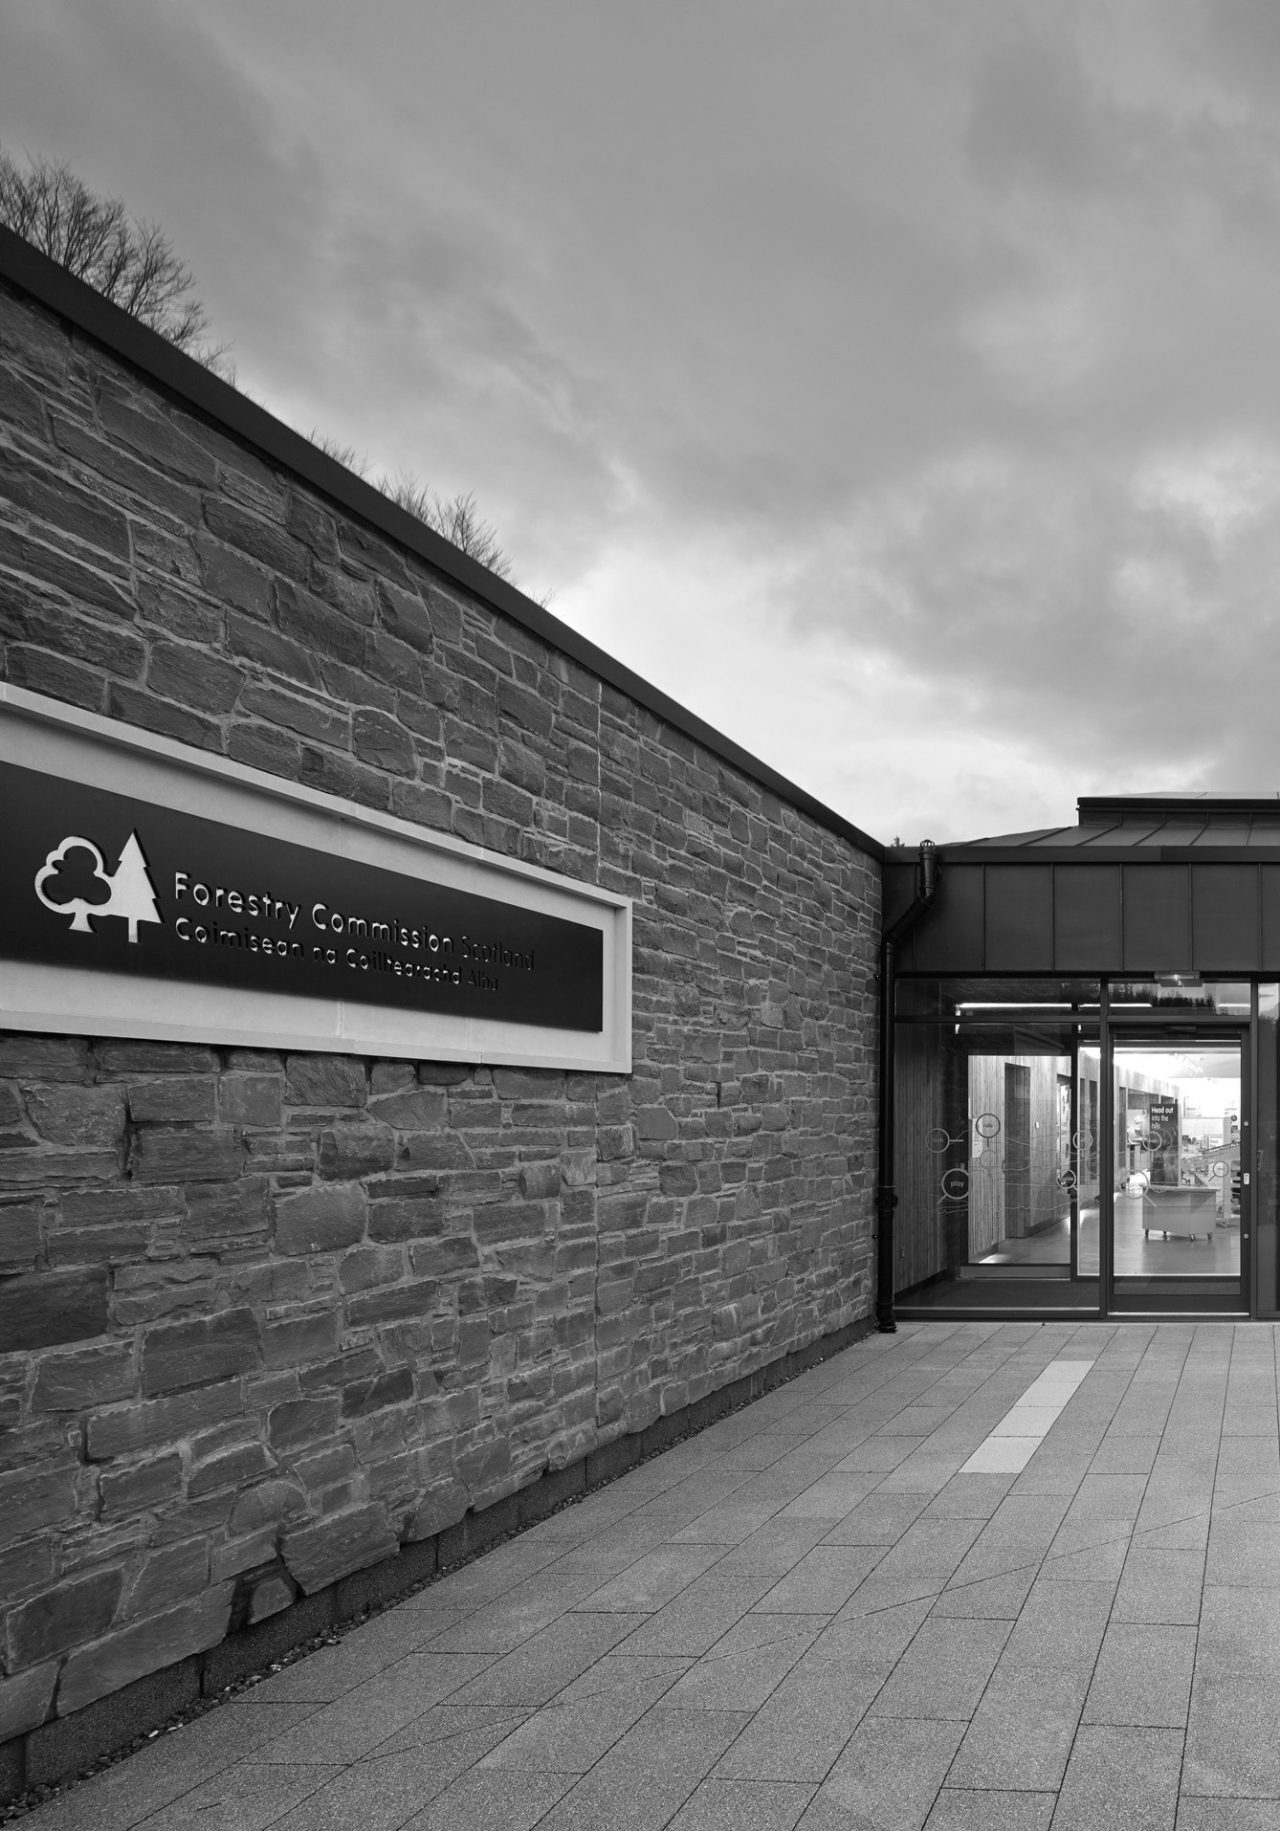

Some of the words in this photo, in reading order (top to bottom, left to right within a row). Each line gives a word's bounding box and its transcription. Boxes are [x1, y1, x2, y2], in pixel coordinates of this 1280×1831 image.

[175, 872, 300, 930] Forestry
[312, 903, 454, 953] Commission
[462, 934, 536, 971] Scotland
[175, 917, 305, 958] Coimisean
[313, 945, 337, 965] na
[346, 948, 462, 985] Coilltearachd
[468, 969, 499, 991] Alba
[1151, 1106, 1164, 1114] Head
[1165, 1106, 1174, 1114] out
